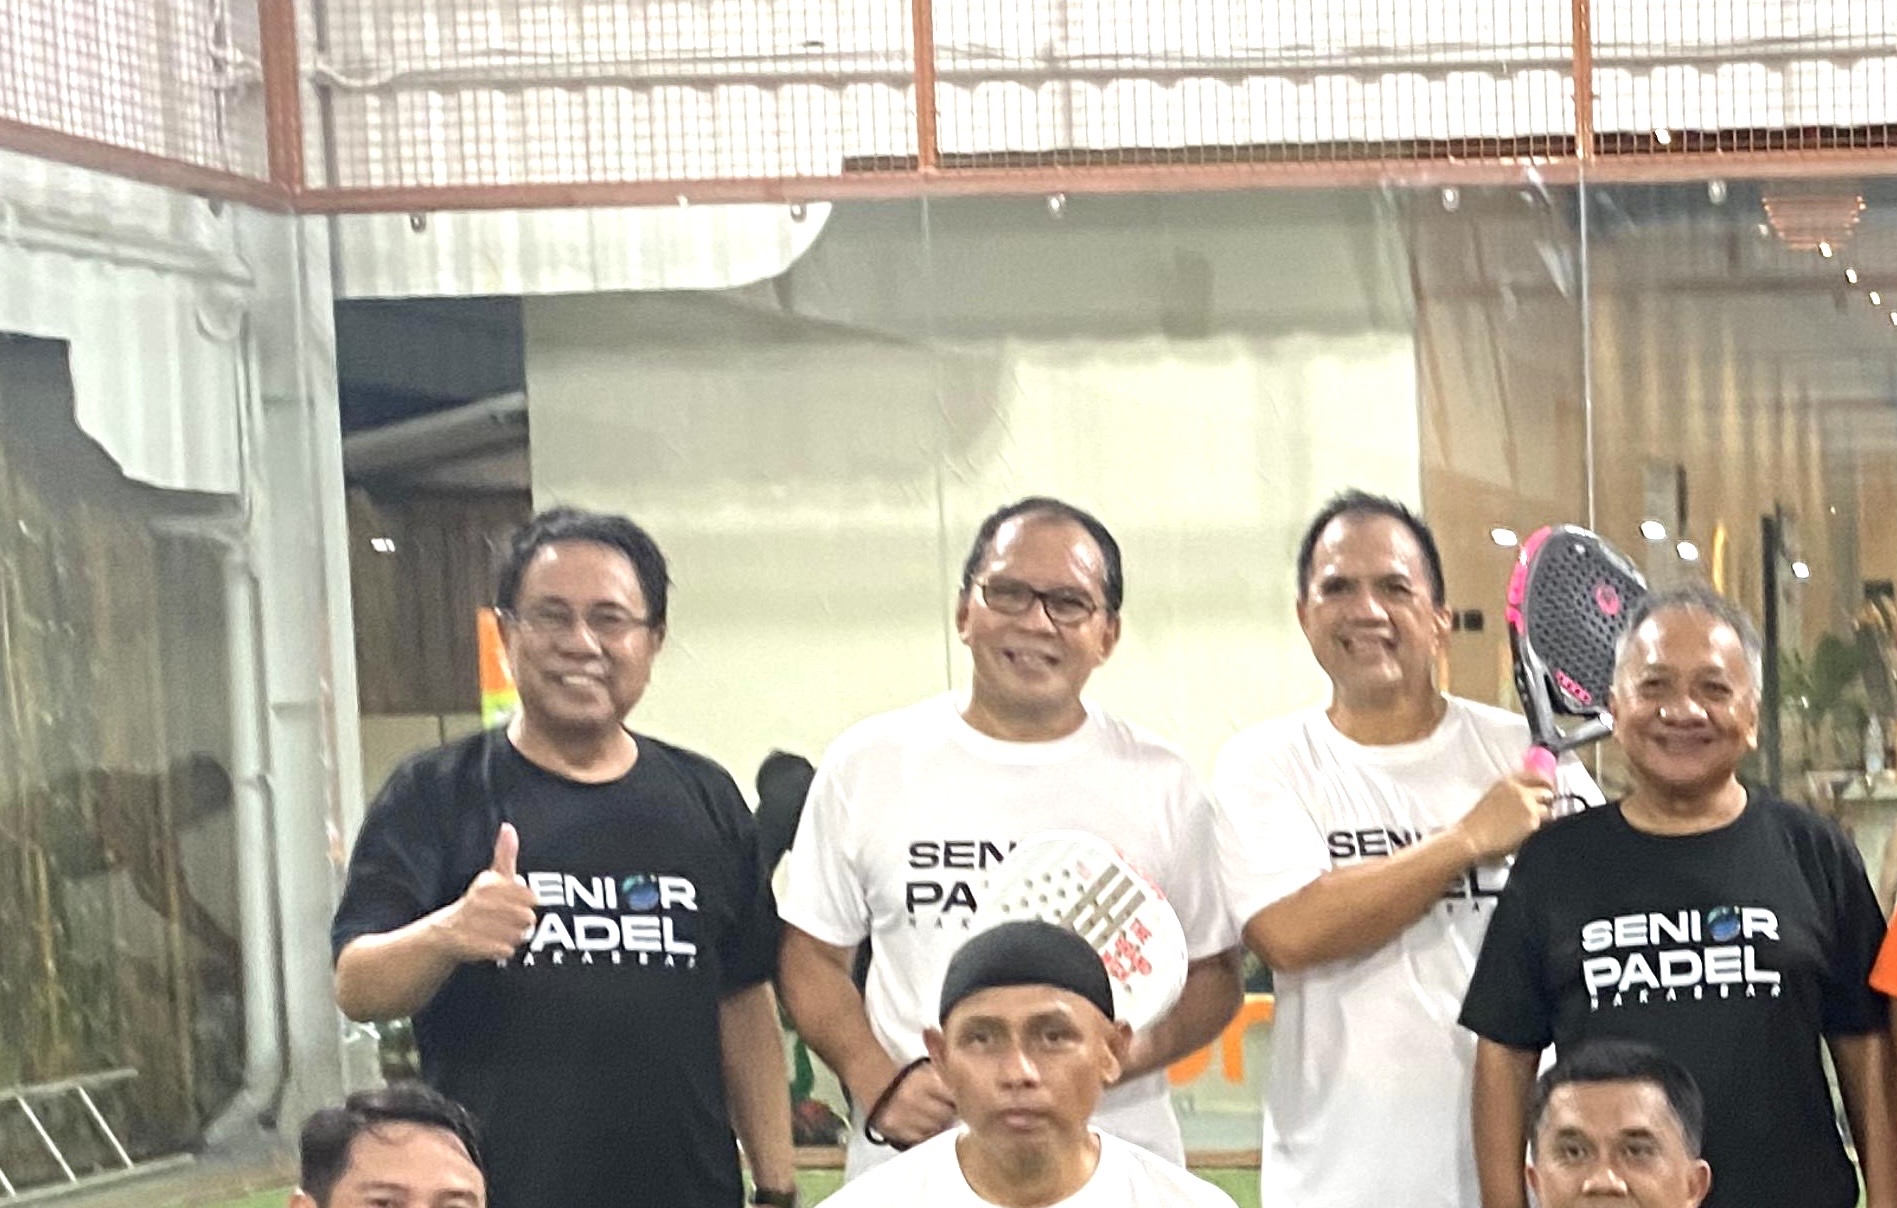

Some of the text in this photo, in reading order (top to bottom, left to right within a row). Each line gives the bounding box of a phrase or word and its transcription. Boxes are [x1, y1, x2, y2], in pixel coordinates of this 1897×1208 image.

[909, 841, 1017, 869] SEN
[1328, 826, 1422, 858] SEN
[524, 872, 698, 911] ENIOR
[530, 913, 697, 955] ADEL
[1581, 905, 1780, 952] SENIOR
[1582, 945, 1782, 997] PADEL
